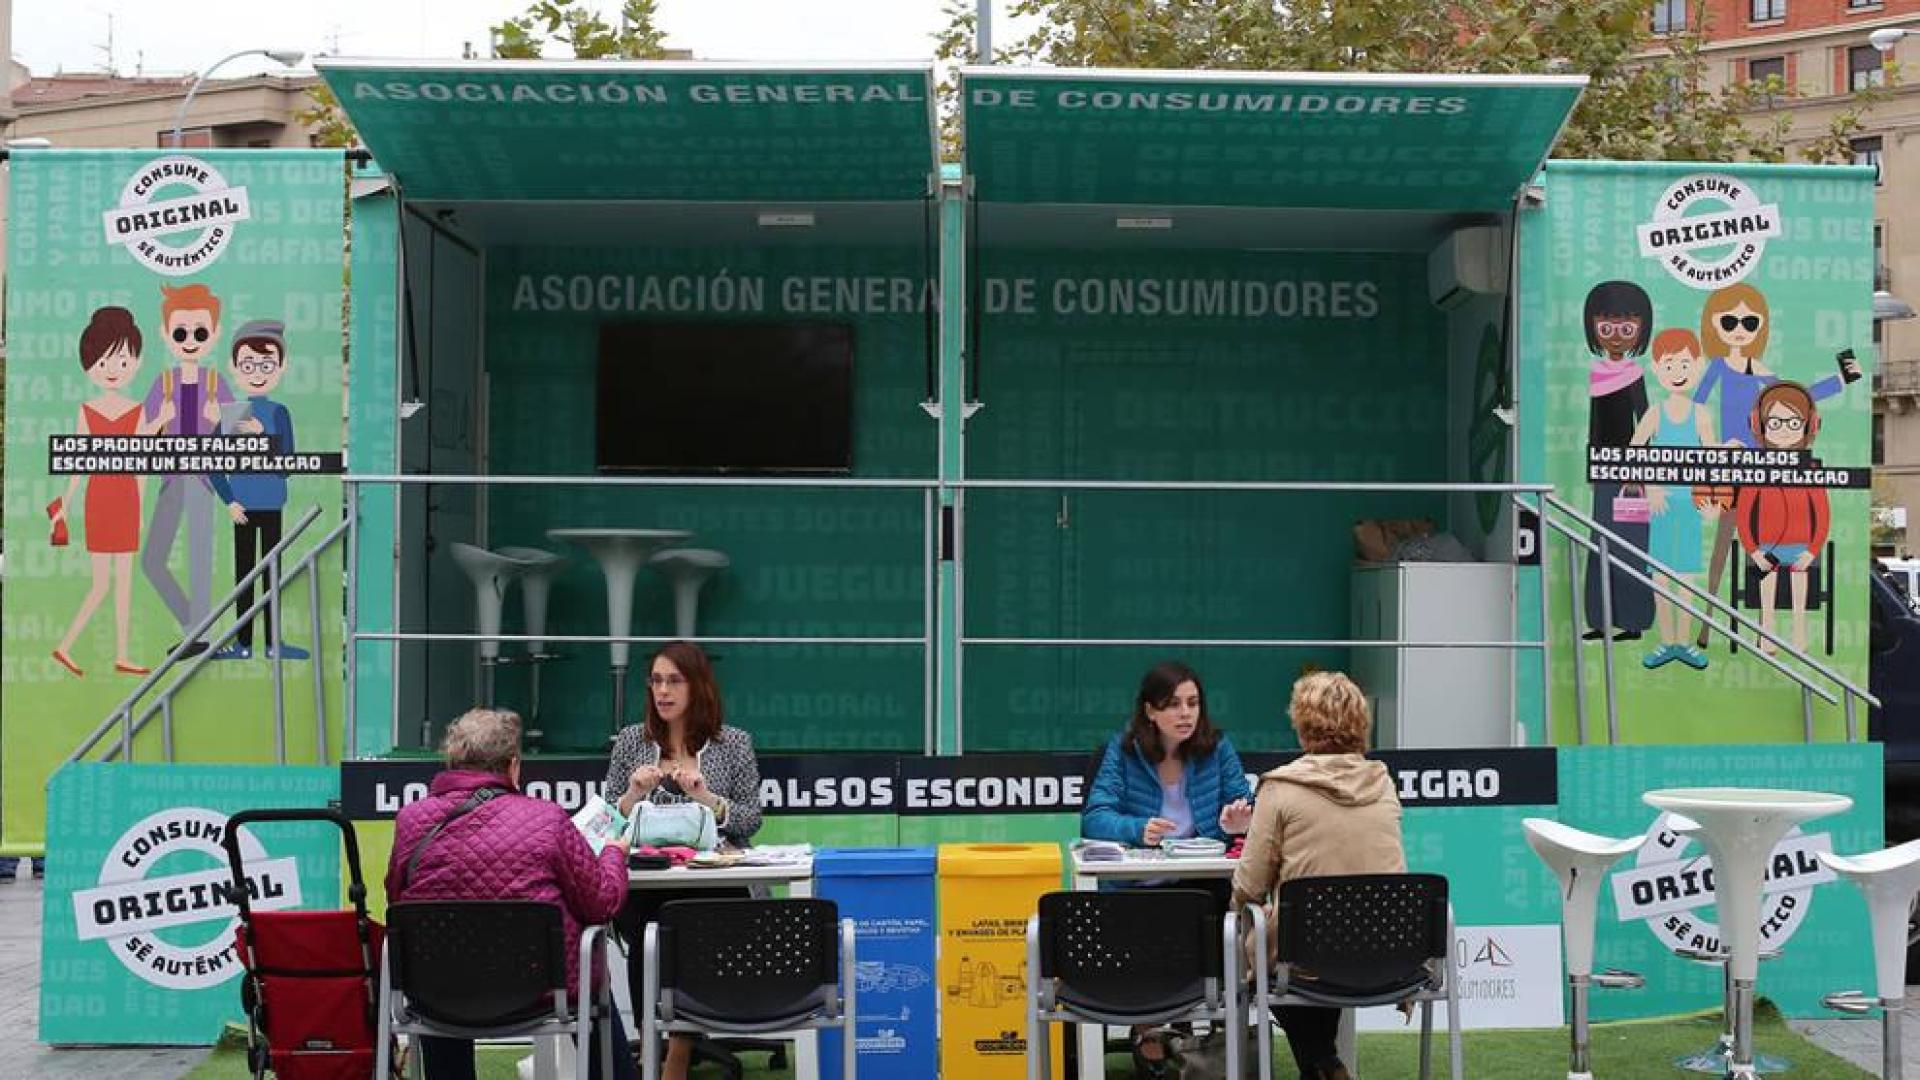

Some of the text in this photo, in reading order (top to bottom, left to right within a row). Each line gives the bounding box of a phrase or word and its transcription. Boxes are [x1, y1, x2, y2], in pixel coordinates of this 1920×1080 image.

[353, 80, 1467, 116] ASOCIACIÓN GENERAL DE CONSUMIDORES
[134, 163, 208, 196] CONSUME
[1667, 180, 1741, 210] CONSUME
[116, 198, 239, 234] ORIGINAL
[1650, 215, 1770, 248] ORIGINAL
[155, 228, 223, 267] AUTÉNTICO
[1687, 244, 1755, 280] AUTÉNTICO
[512, 266, 1380, 319] ASOCIACIÓN GENERA DE CONSUMIDORES
[53, 438, 269, 452] LOS PRODUCTOS FALSOS
[1590, 447, 1799, 466] LOS PRODUCTOS FALSOS
[52, 456, 321, 470] ESCONDEN UN SERIO PELIGRO
[1590, 465, 1849, 486] ESCONDEN UN SERIO PELIGRO
[759, 776, 893, 808] ALSOS
[906, 775, 1085, 808] ESCONDE
[1397, 769, 1500, 799] IGRO
[122, 820, 230, 868] CONSUM
[152, 941, 238, 976] AUTÉNT
